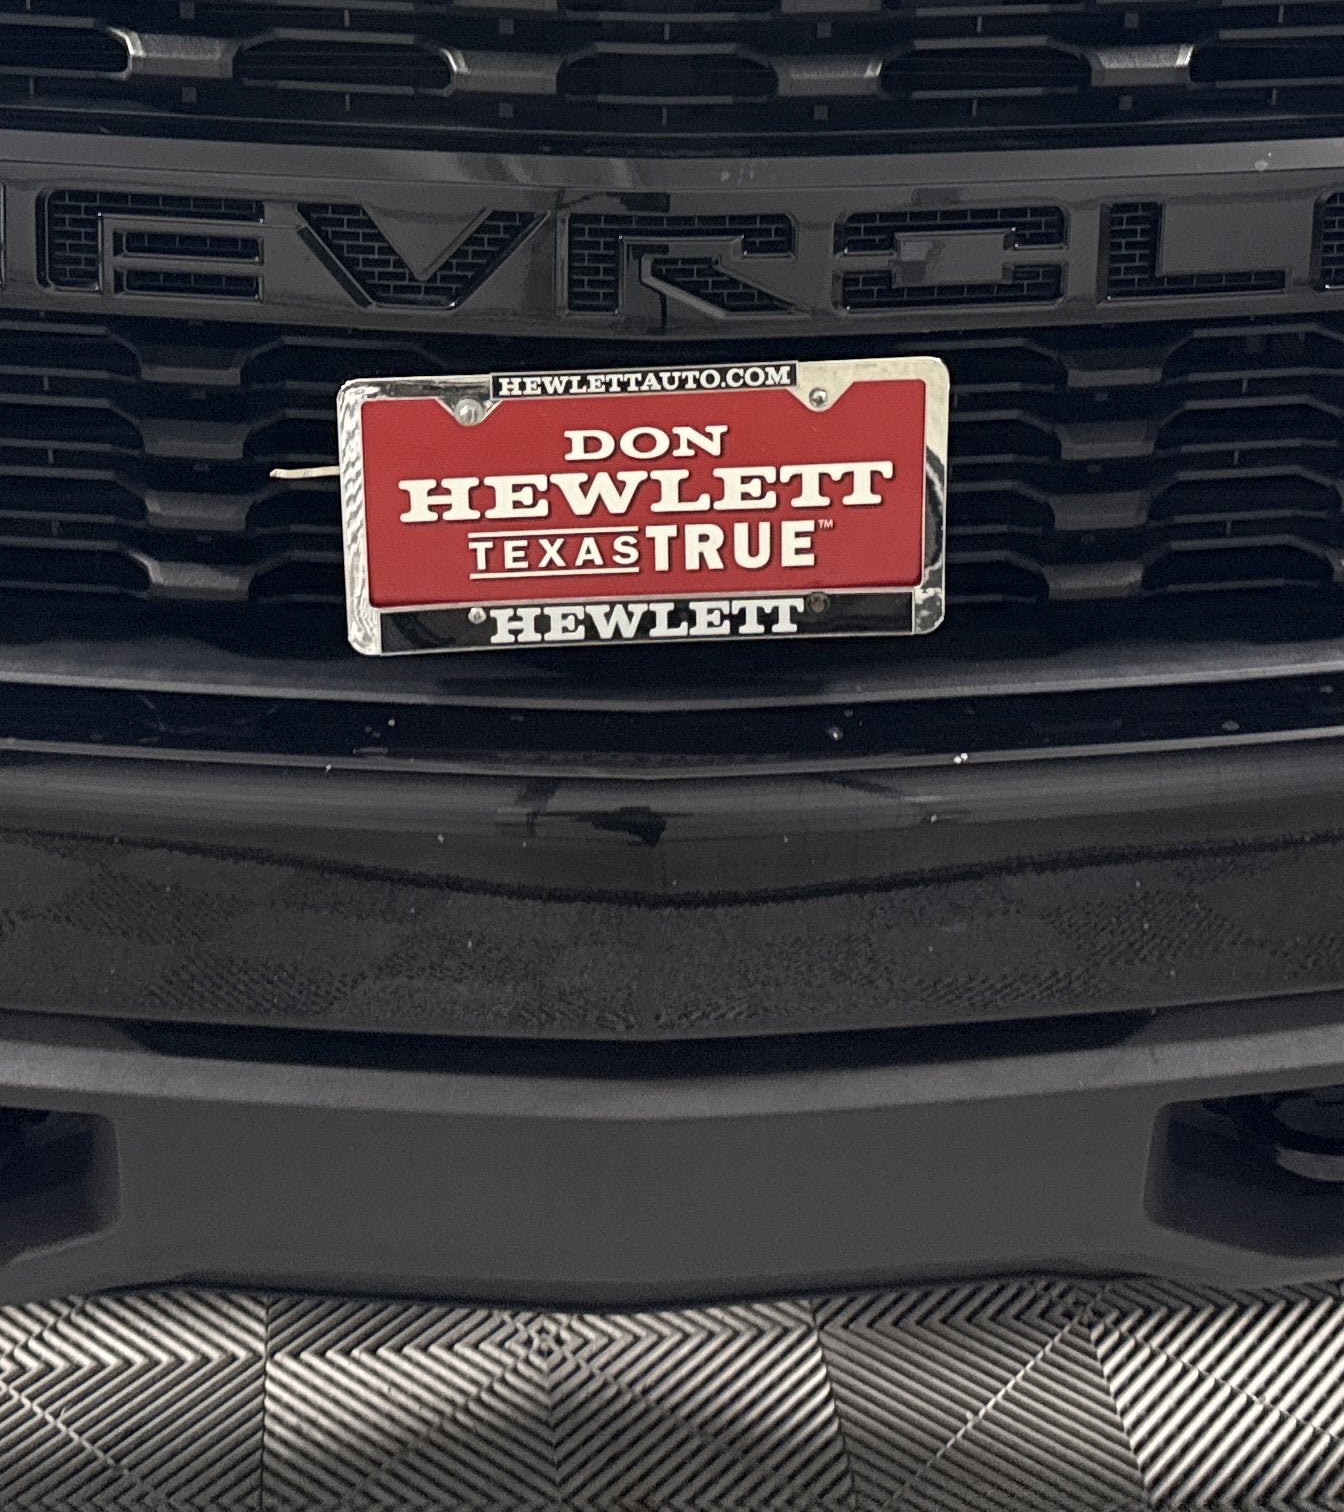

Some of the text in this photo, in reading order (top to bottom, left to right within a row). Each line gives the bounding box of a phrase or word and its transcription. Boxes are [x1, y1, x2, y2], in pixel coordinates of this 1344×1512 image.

[499, 366, 790, 397] HEWLETTAUTO.COM
[563, 425, 729, 461] DON
[398, 461, 893, 522] HEWLETT
[490, 599, 804, 643] HEWLETT
